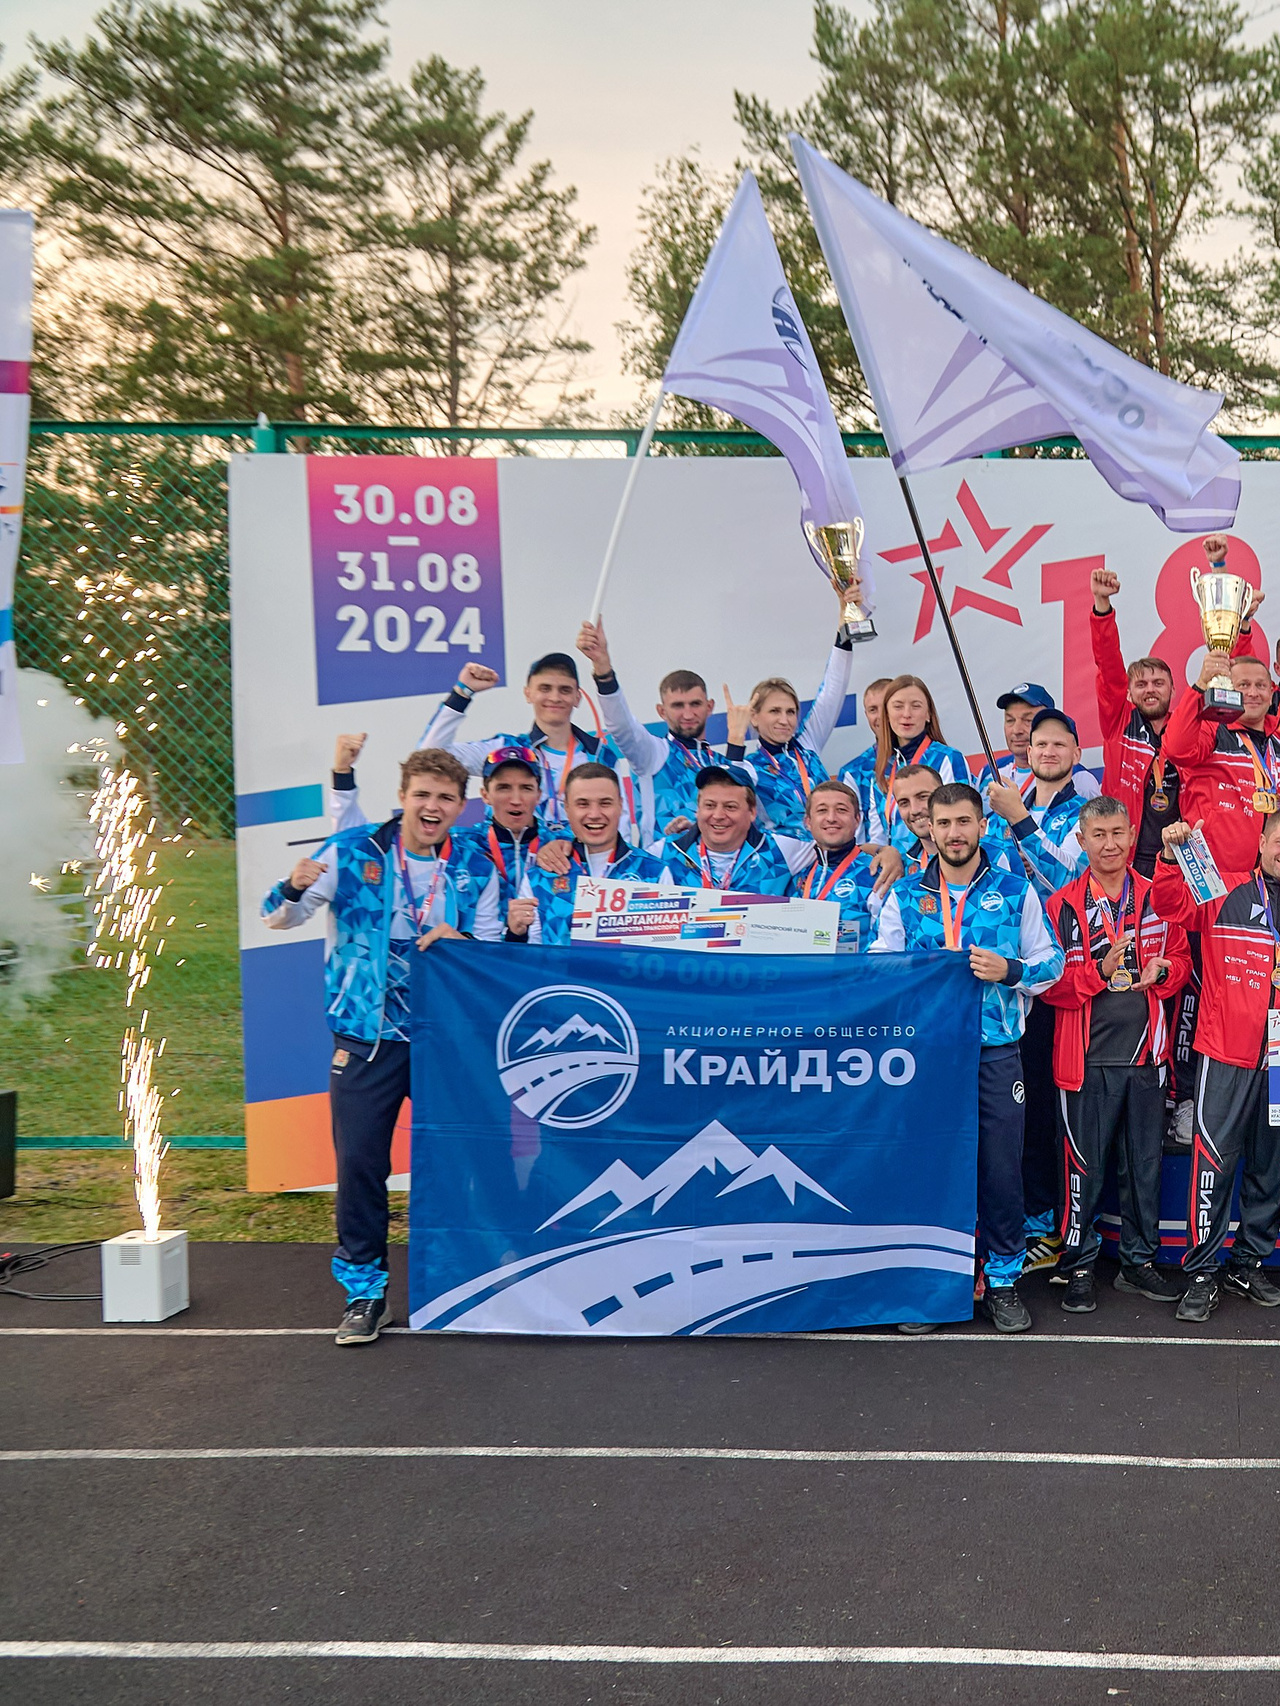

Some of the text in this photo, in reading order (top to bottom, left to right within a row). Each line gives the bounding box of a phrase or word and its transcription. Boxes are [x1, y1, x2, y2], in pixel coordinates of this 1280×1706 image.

[333, 483, 479, 525] 30.08
[335, 551, 482, 593] 31.08
[335, 605, 486, 653] 2024
[1041, 533, 1271, 750] 18
[595, 888, 626, 912] 18
[598, 912, 689, 927] СПАРТАКИАДА
[628, 901, 680, 911] ОТРАСЛЕВАЯ
[1225, 974, 1242, 983] MSU
[666, 1025, 916, 1039] АКЦИОНЕРНОЕ ОБЩЕСТВО
[1177, 994, 1195, 1063] БРИЗ
[1066, 1173, 1081, 1247] БРИЗ
[1197, 1169, 1215, 1245] БРИЗ
